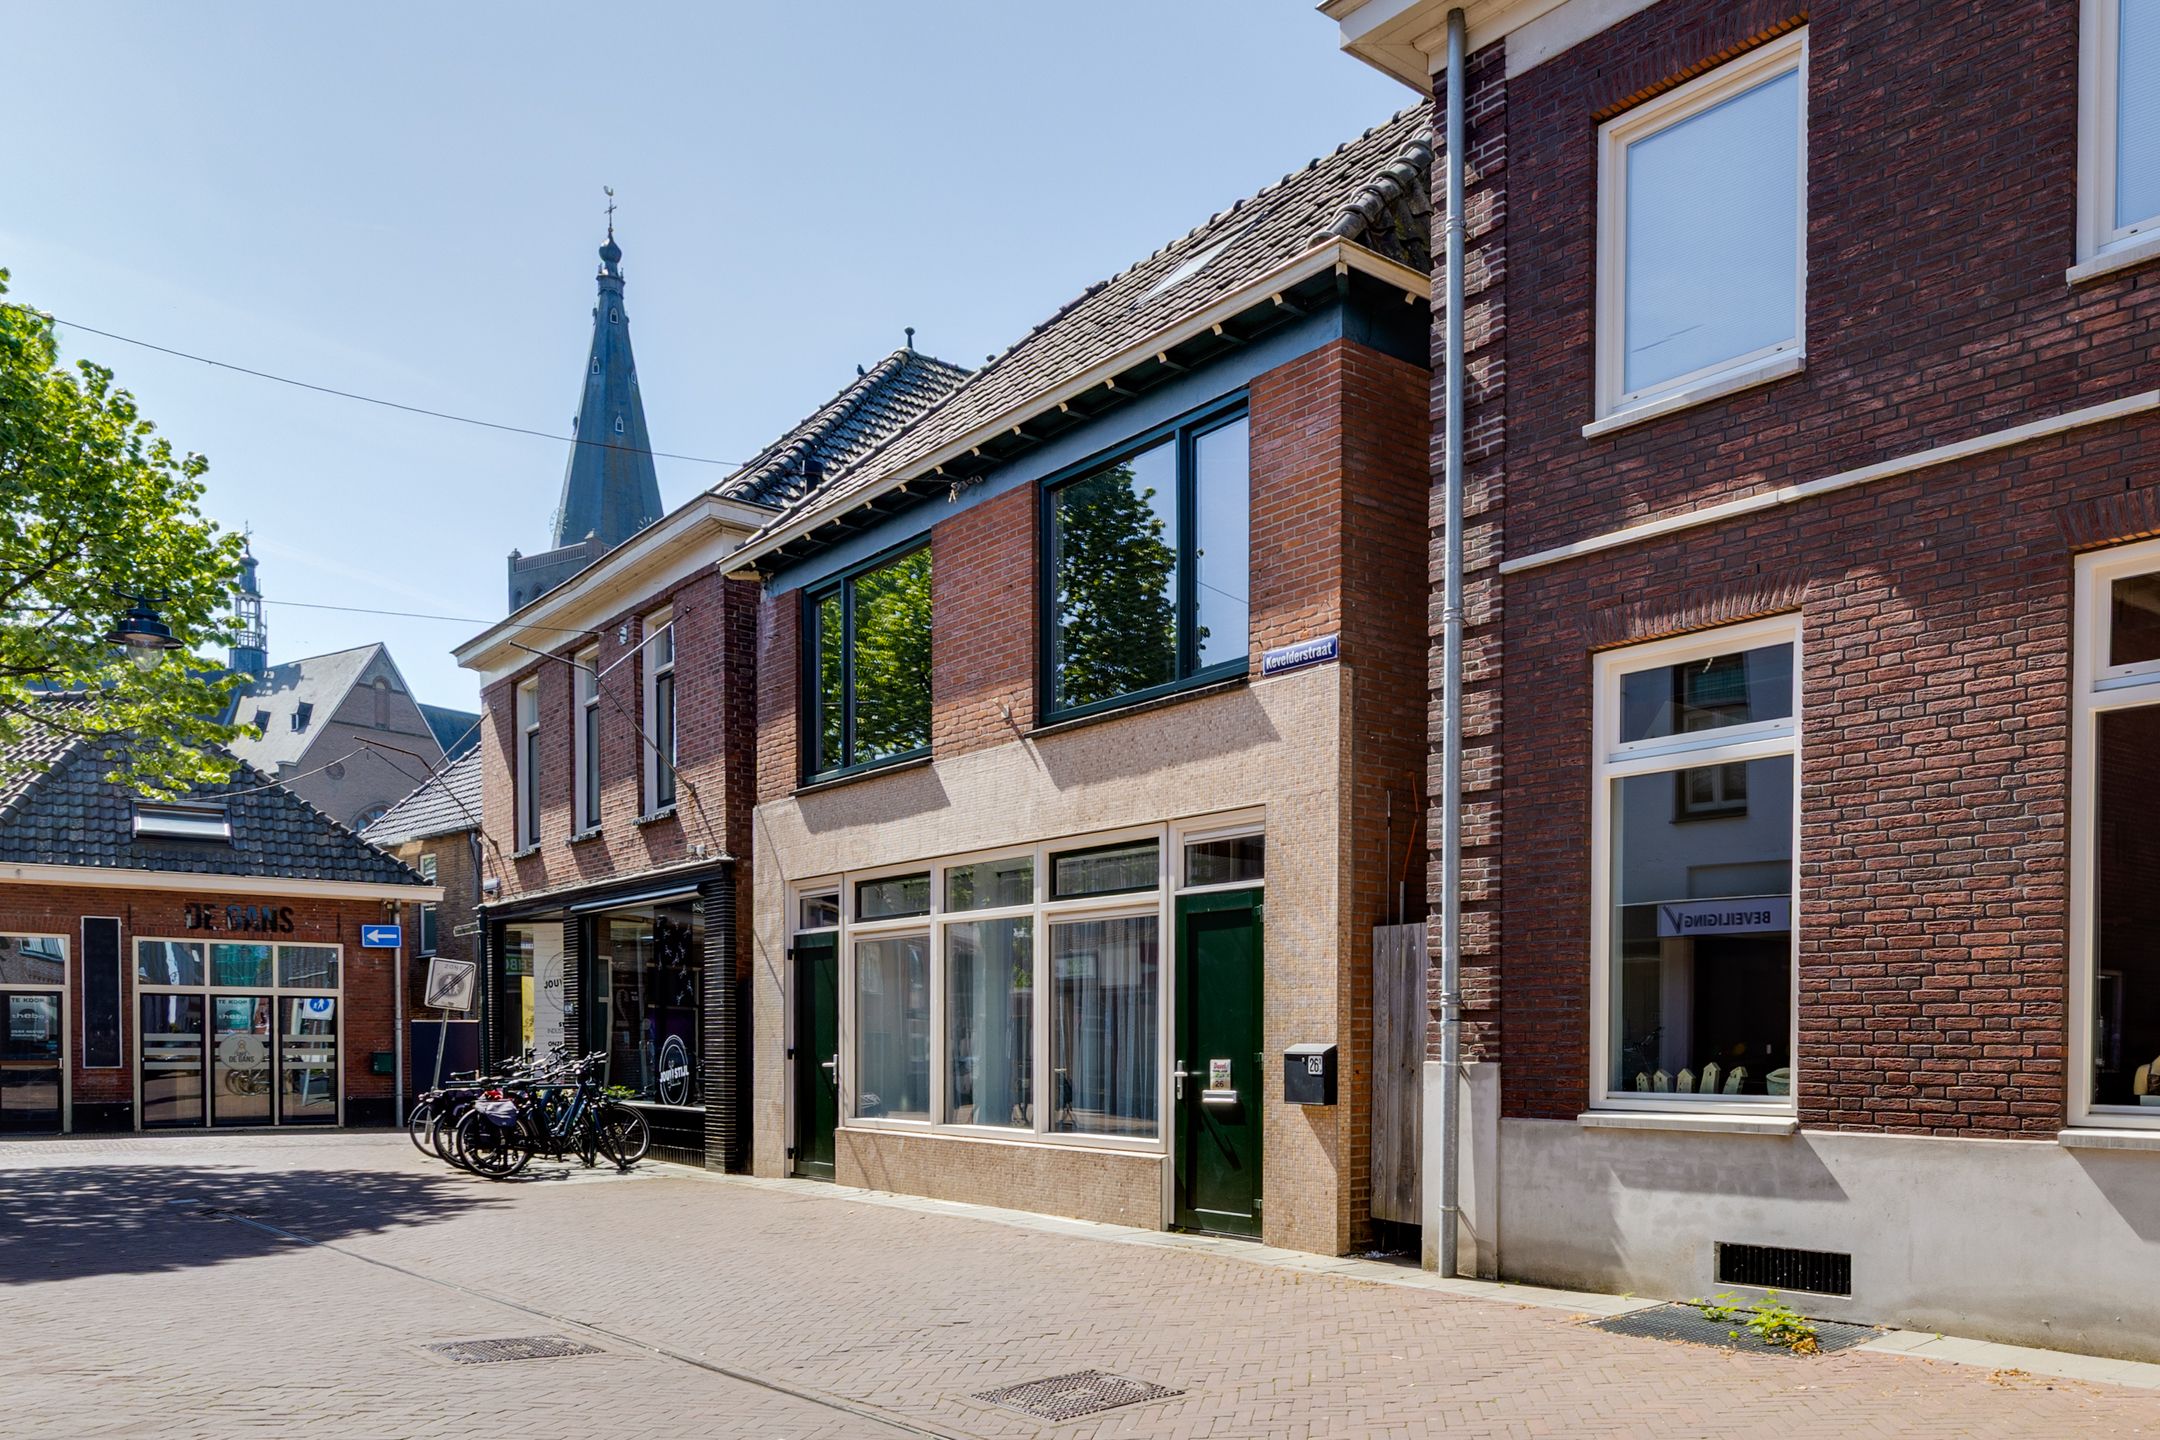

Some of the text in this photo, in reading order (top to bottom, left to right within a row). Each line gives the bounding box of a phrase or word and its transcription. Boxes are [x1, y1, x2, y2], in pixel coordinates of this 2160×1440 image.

[1266, 641, 1333, 669] Kevelderstraat
[184, 903, 294, 933] DE GANS
[1215, 1080, 1225, 1088] 26
